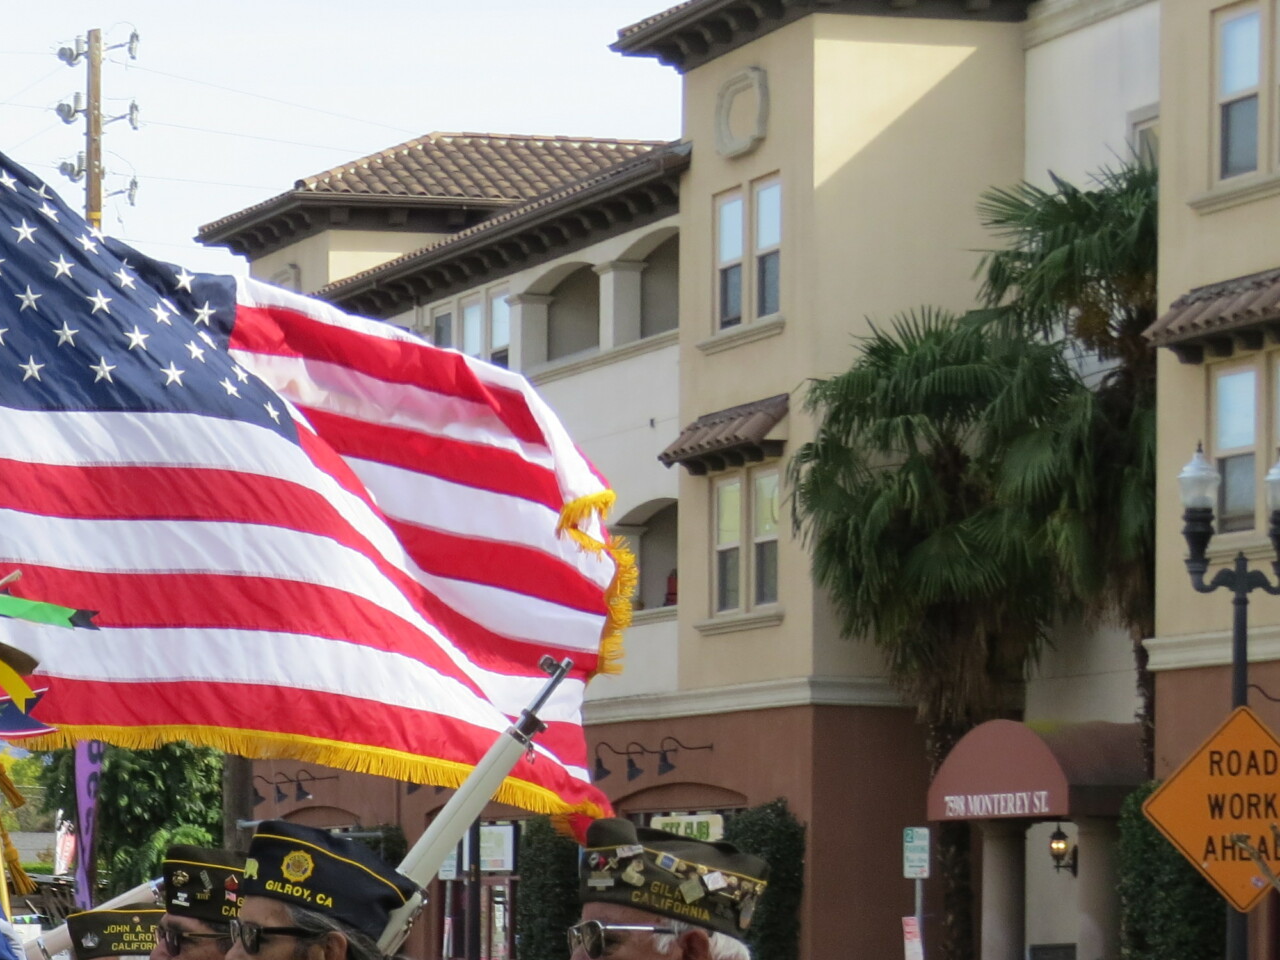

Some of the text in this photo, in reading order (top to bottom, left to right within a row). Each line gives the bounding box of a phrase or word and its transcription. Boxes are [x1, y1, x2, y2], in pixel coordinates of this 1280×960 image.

[1209, 750, 1278, 777] ROAD
[967, 791, 1032, 816] MONTEREY
[1207, 793, 1279, 820] WORK
[265, 880, 311, 902] GILROY,
[316, 893, 333, 908] CA
[631, 890, 711, 922] CALIFORNIA
[103, 924, 130, 934] JOHN
